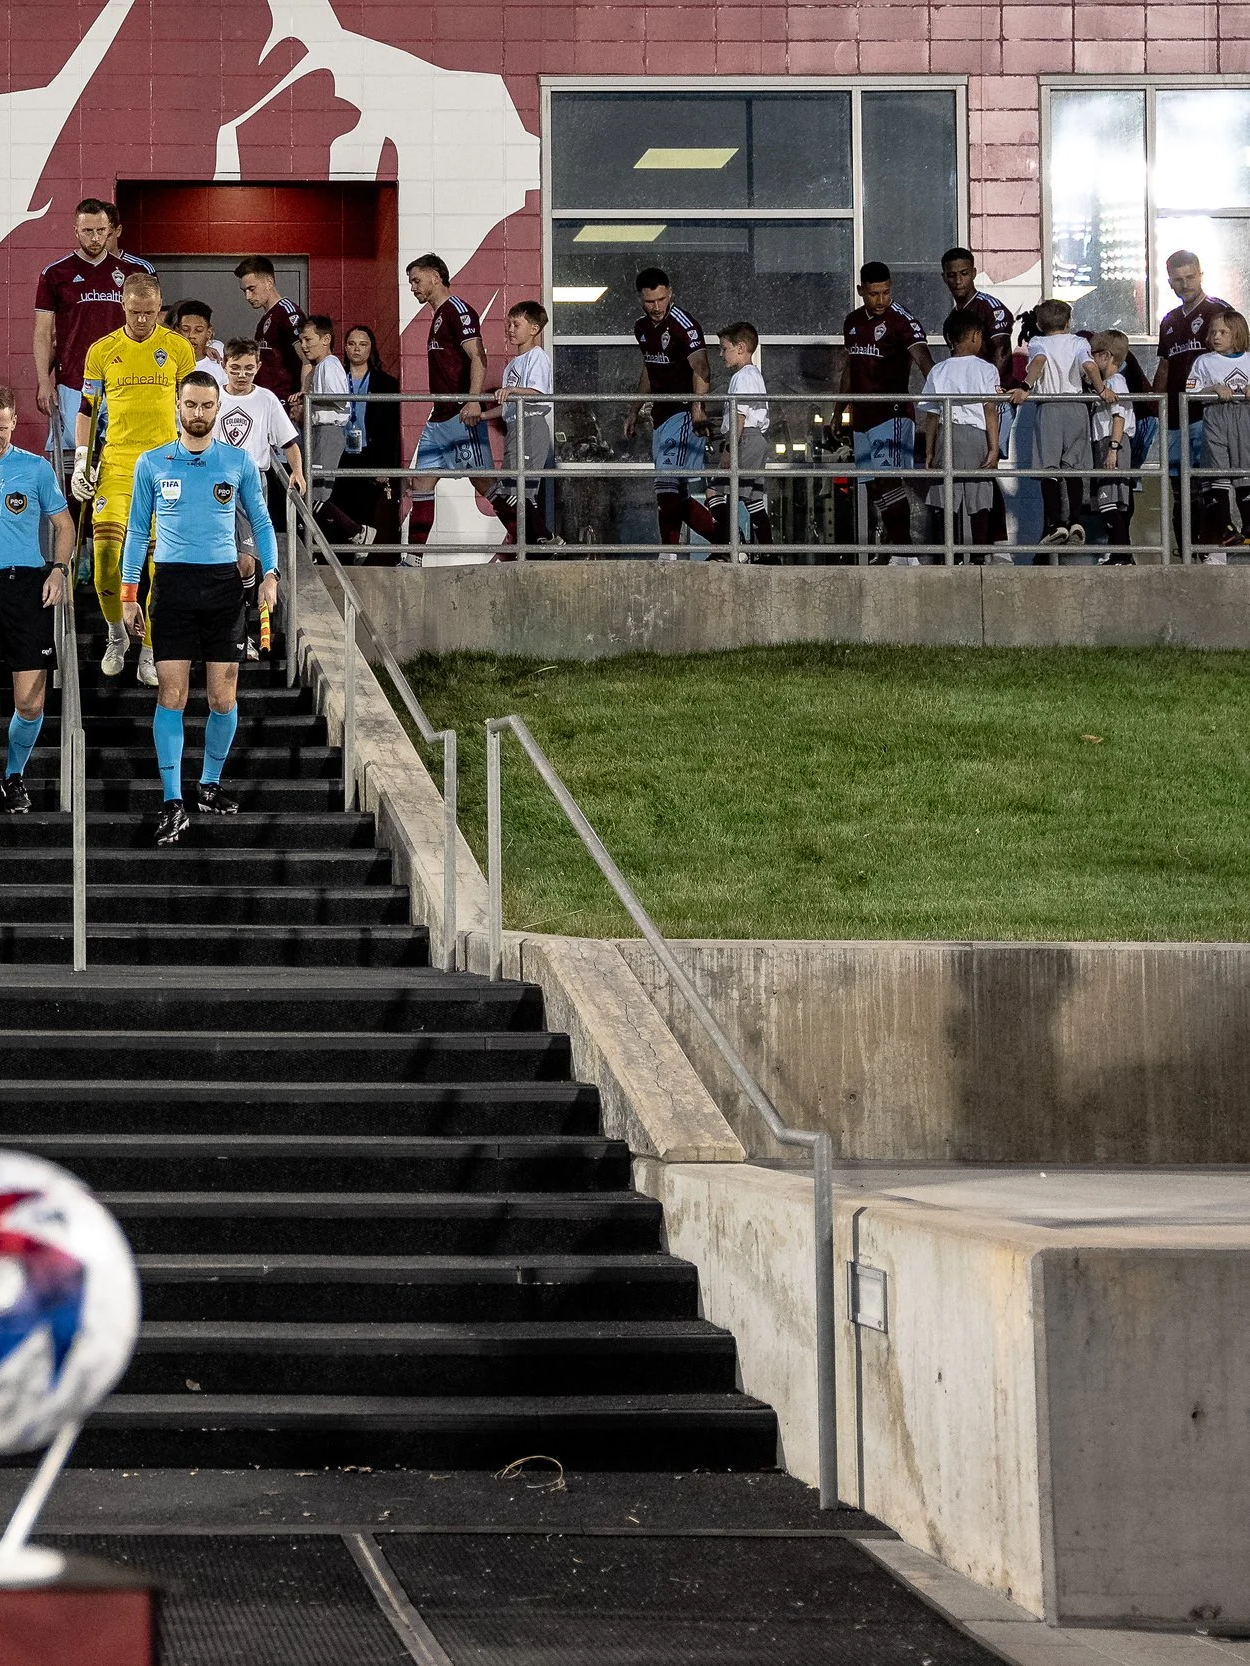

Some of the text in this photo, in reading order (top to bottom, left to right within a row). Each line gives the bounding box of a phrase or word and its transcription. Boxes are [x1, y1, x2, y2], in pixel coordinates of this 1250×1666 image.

[80, 289, 123, 301] uchealth
[850, 343, 880, 355] chealth
[644, 352, 670, 363] health
[118, 372, 169, 387] uchealth
[663, 438, 677, 457] 2
[871, 438, 893, 459] 21
